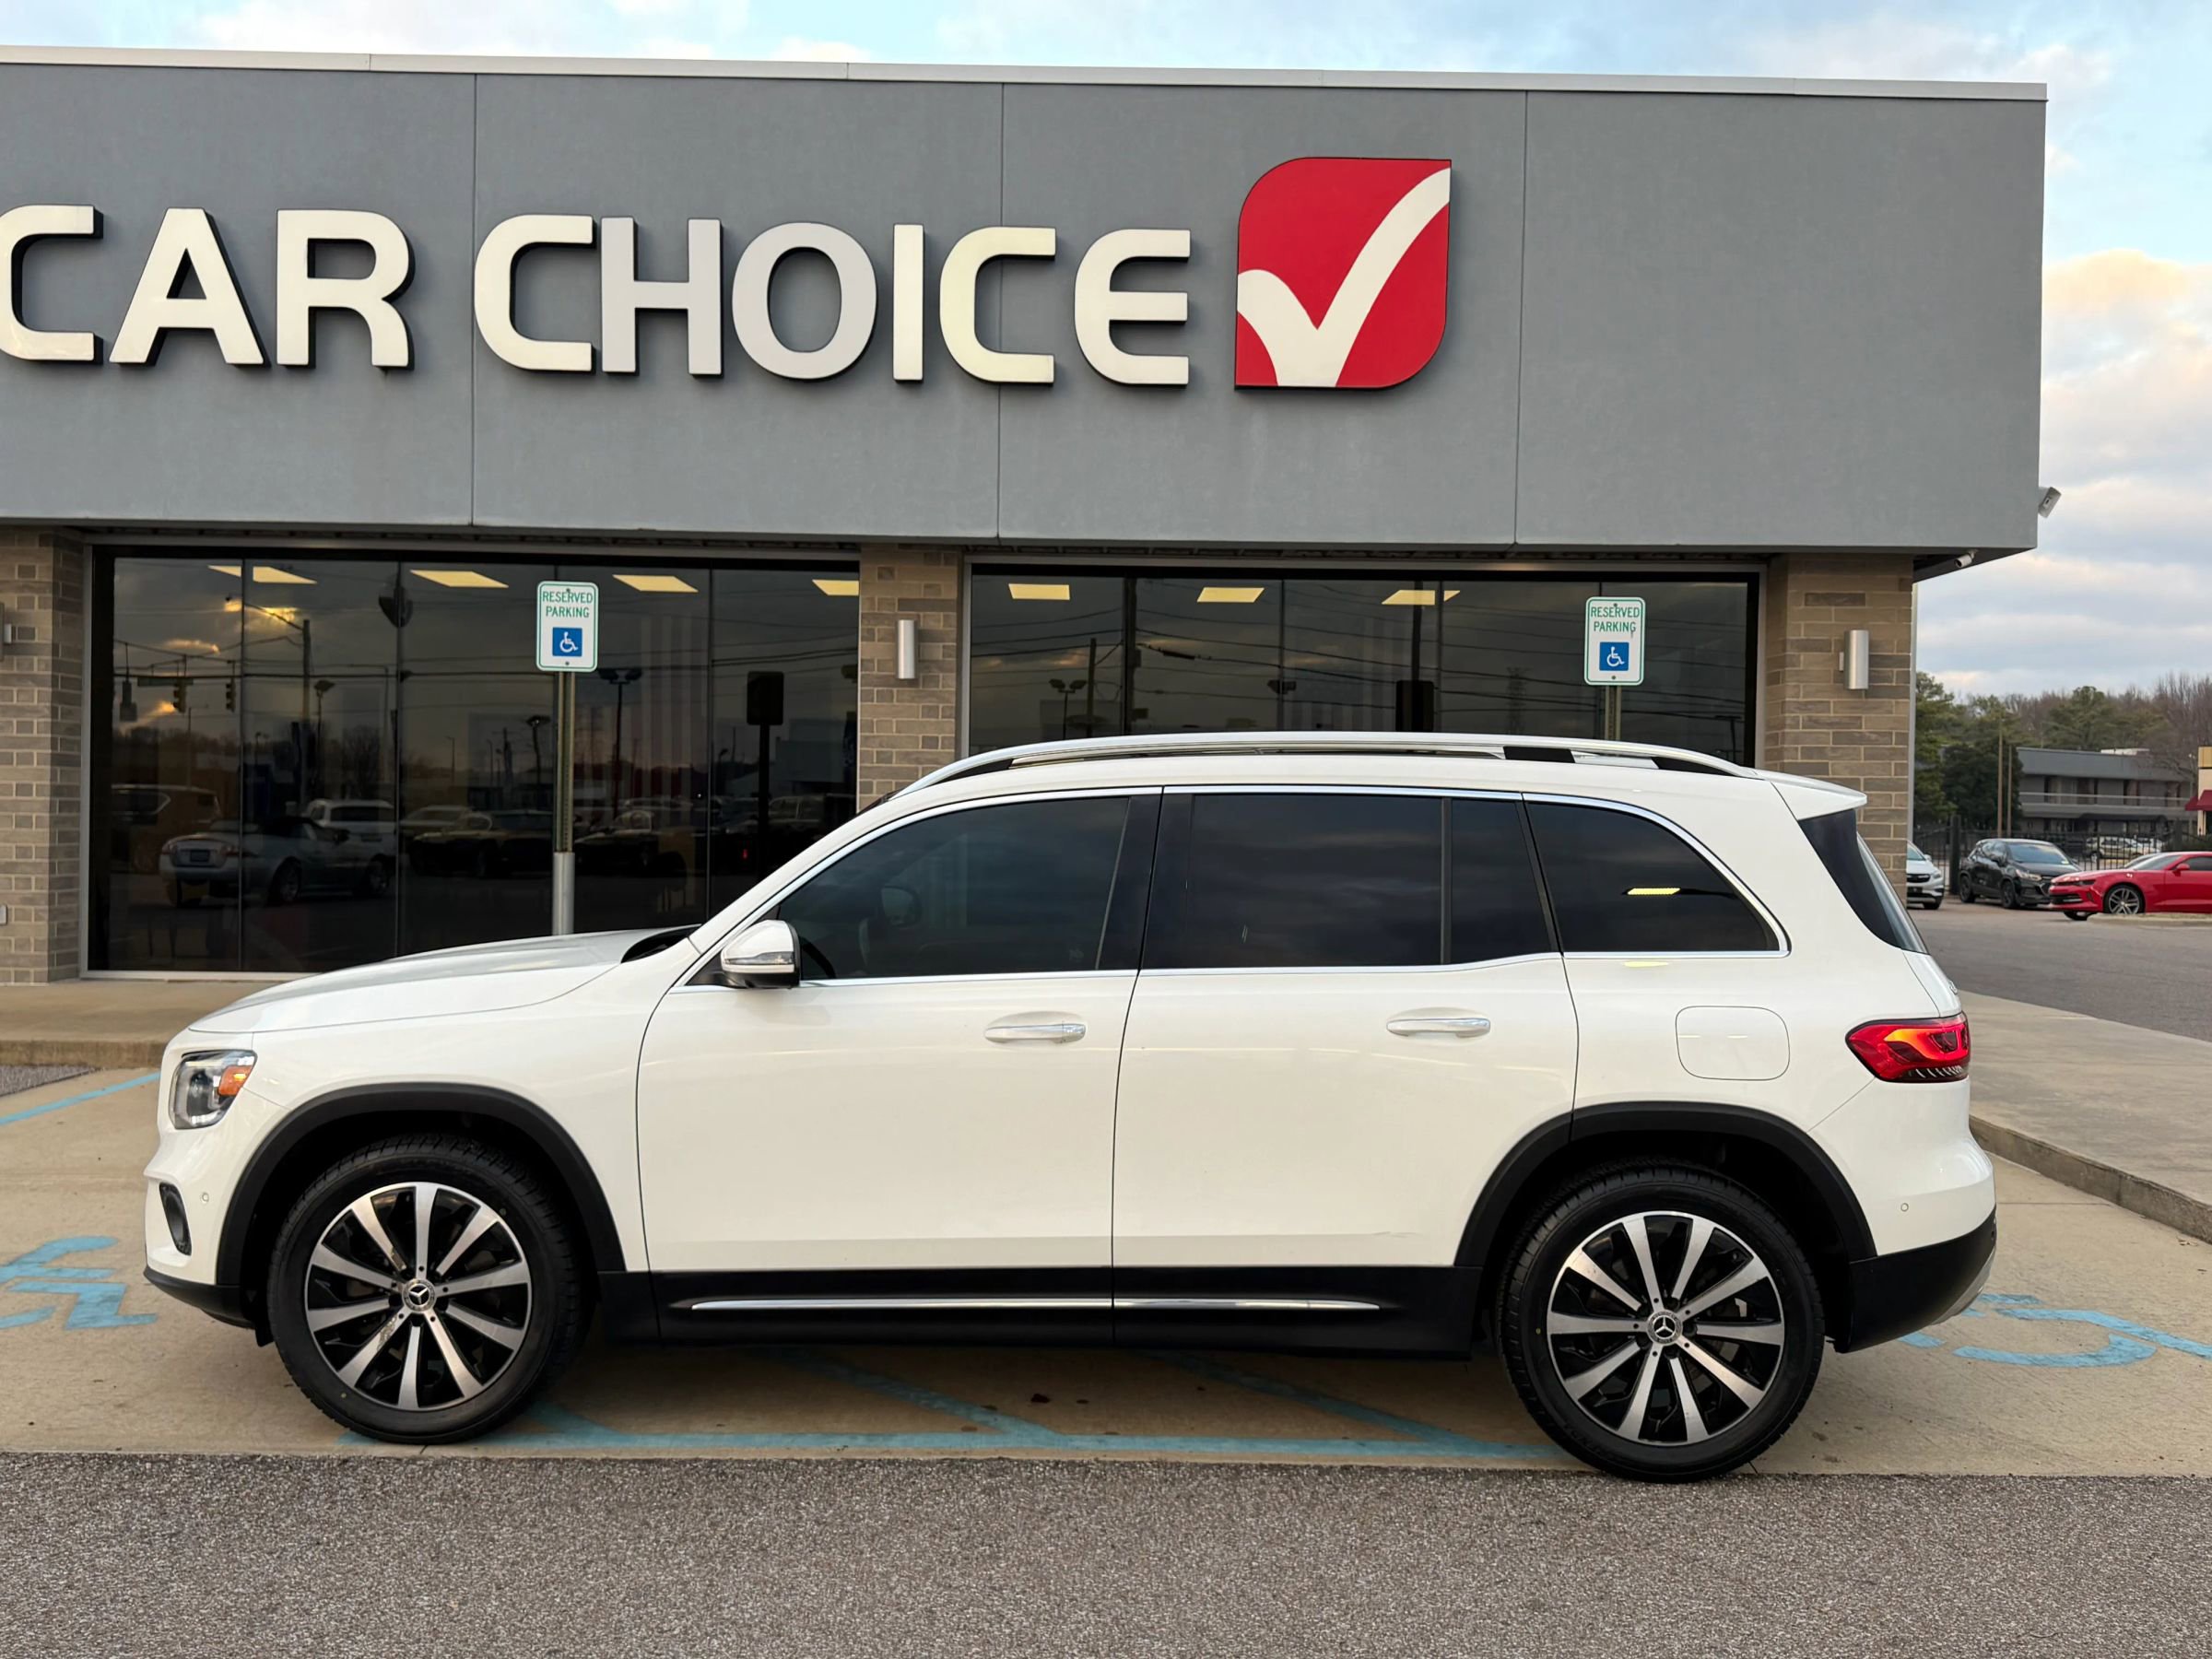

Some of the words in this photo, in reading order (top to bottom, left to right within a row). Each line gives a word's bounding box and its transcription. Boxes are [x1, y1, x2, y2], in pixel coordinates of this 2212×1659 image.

[0, 205, 414, 371] CAR
[474, 215, 1193, 385] CHOICE
[543, 591, 593, 603] RESERVED
[546, 606, 590, 618] PARKING
[1591, 607, 1640, 618] RESERVED
[1594, 621, 1636, 632] PARKING
